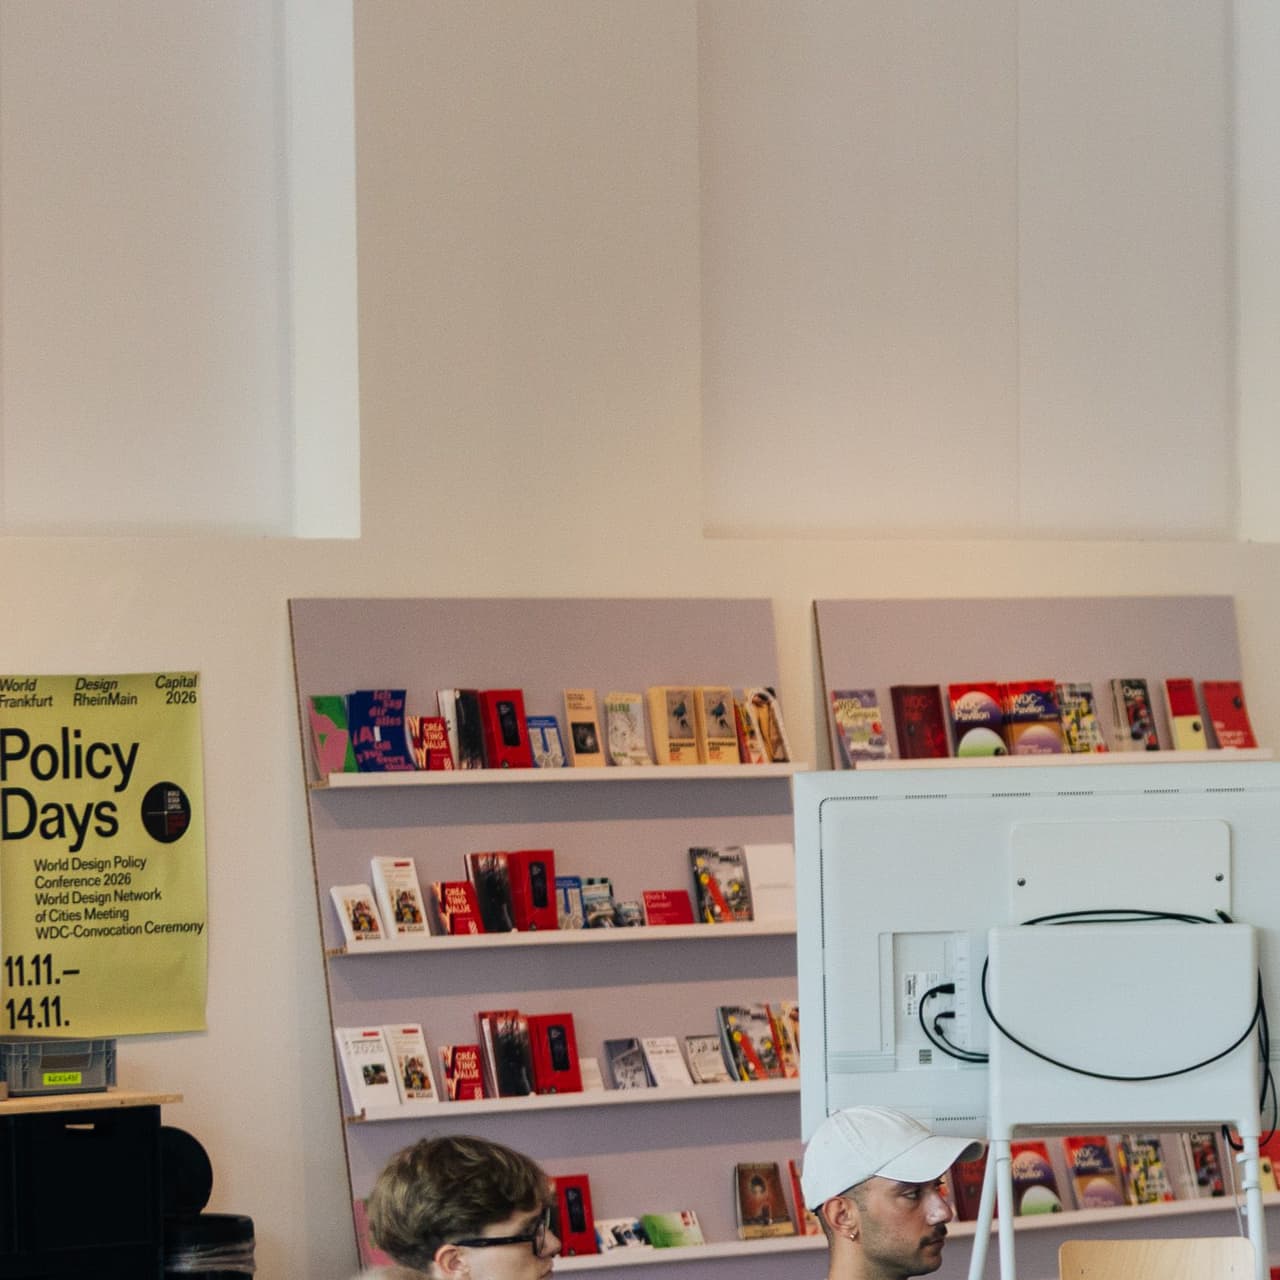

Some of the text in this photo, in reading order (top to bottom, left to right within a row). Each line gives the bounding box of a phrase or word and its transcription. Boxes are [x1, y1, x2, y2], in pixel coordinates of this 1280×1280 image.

[0, 675, 197, 693] World Design Capital
[0, 691, 197, 708] Frankfurt RheinMain 2026
[0, 727, 139, 792] Policy
[1, 787, 119, 852] Days
[34, 856, 147, 872] World Design Policy
[35, 873, 132, 889] Conference 2026
[35, 888, 162, 906] World Design Network
[35, 907, 129, 923] of Cities Meeting
[35, 920, 205, 940] WDC-Convocation Ceremony
[6, 995, 70, 1030] 14.11.
